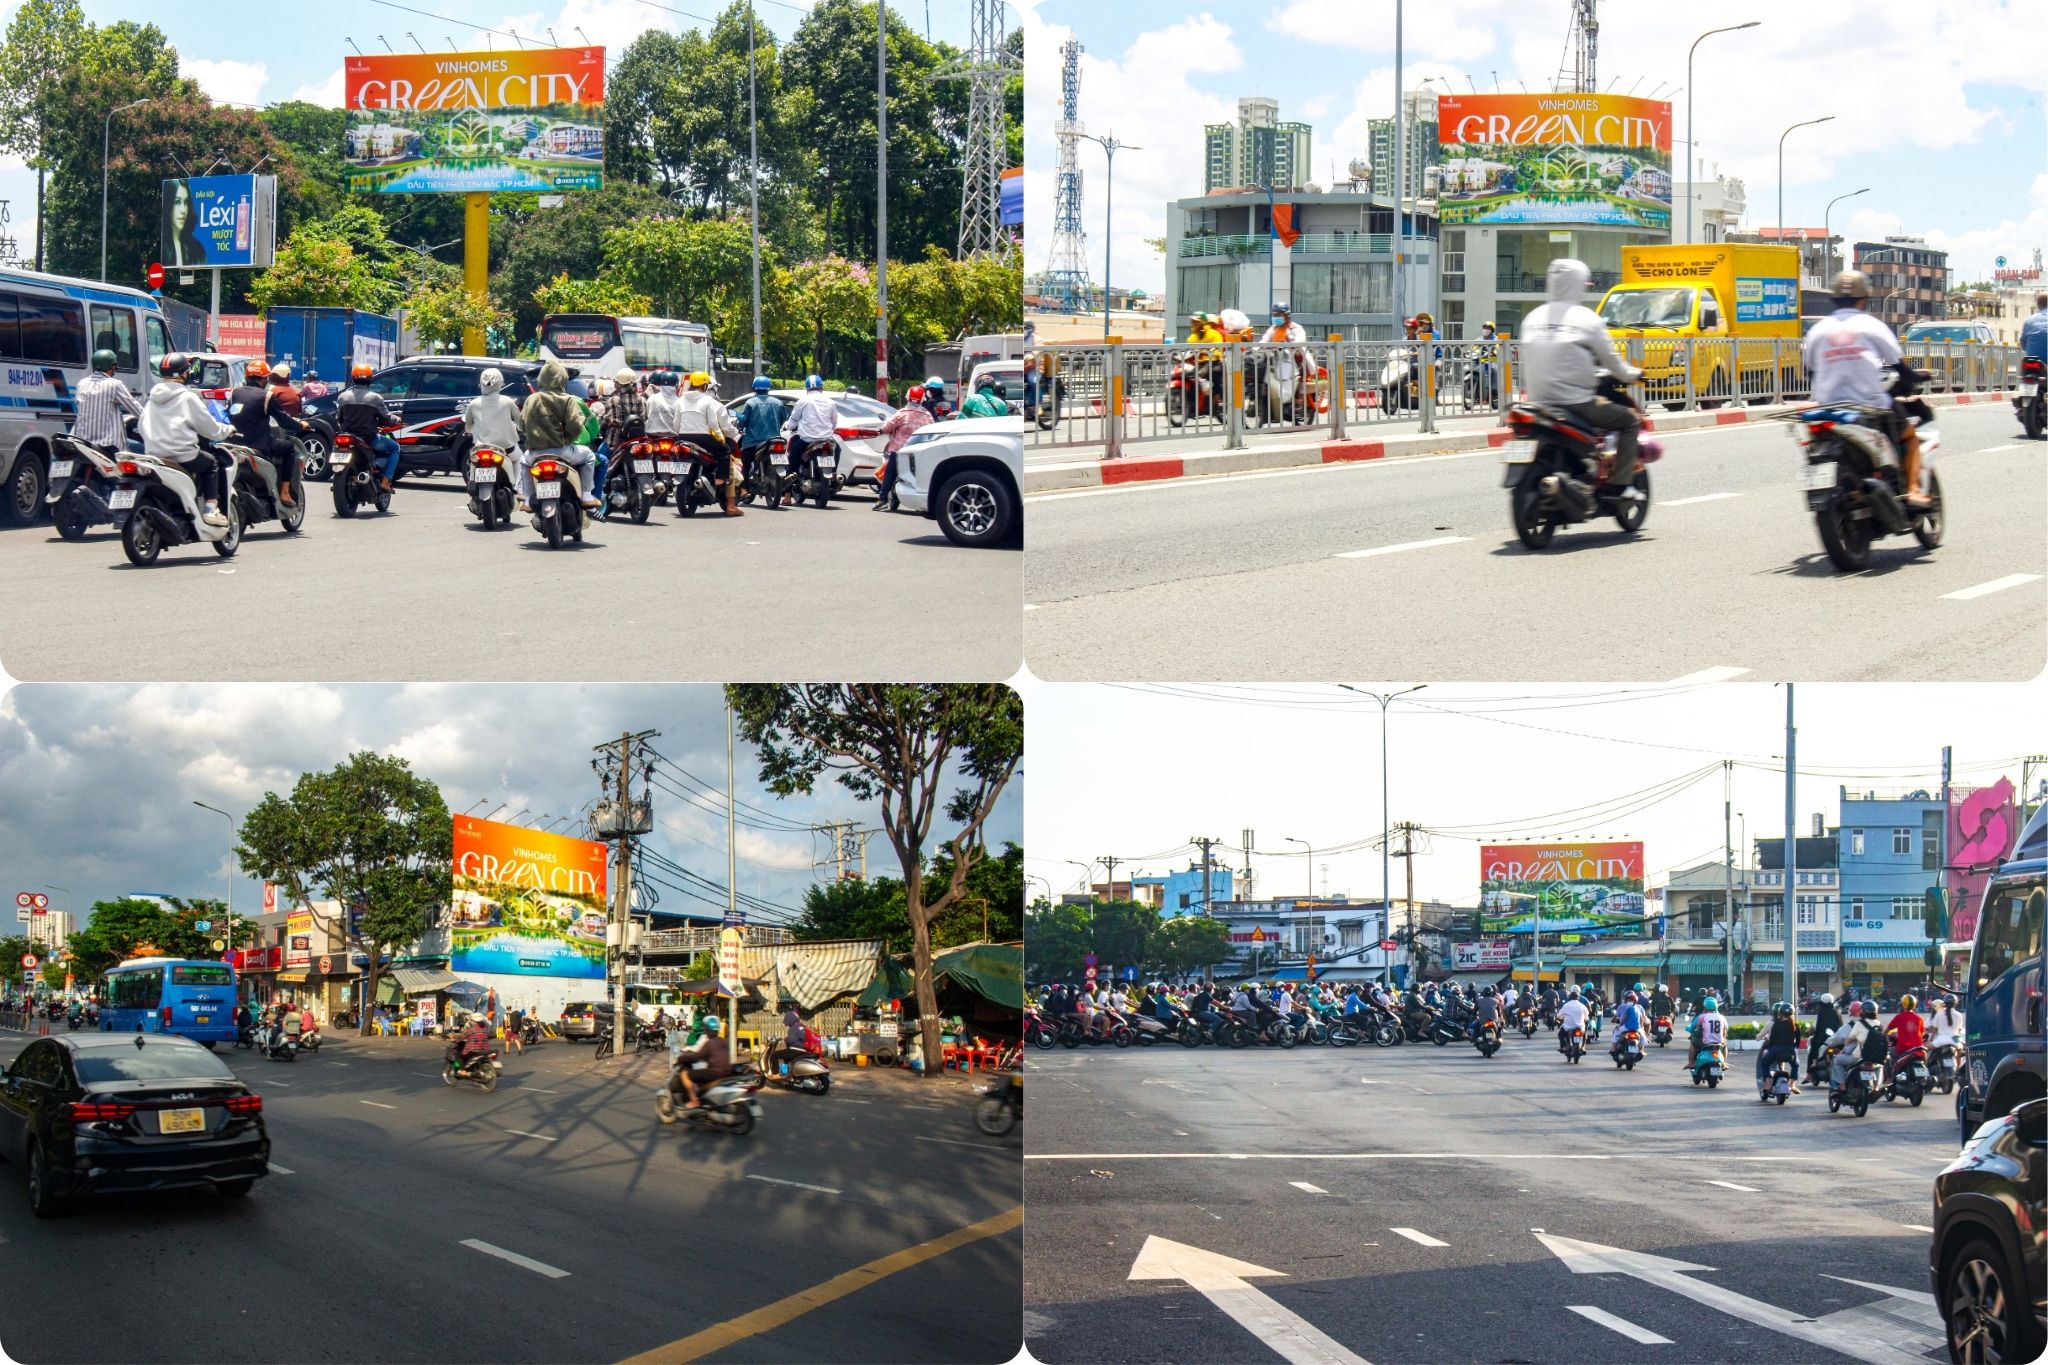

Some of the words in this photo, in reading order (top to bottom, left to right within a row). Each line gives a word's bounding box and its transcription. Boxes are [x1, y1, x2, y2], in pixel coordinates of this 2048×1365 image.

[435, 60, 508, 73] VINHOMES
[498, 73, 589, 108] CITY
[1538, 100, 1599, 111] VINHOMES
[1594, 116, 1662, 147] CITY
[513, 848, 558, 864] VINHOMES
[1537, 850, 1583, 858] VINHOMES
[1576, 859, 1635, 880] CITY
[550, 867, 601, 896] CITY
[1866, 920, 1884, 930] 69
[1458, 953, 1477, 963] ZIC
[1708, 1020, 1721, 1034] 18
